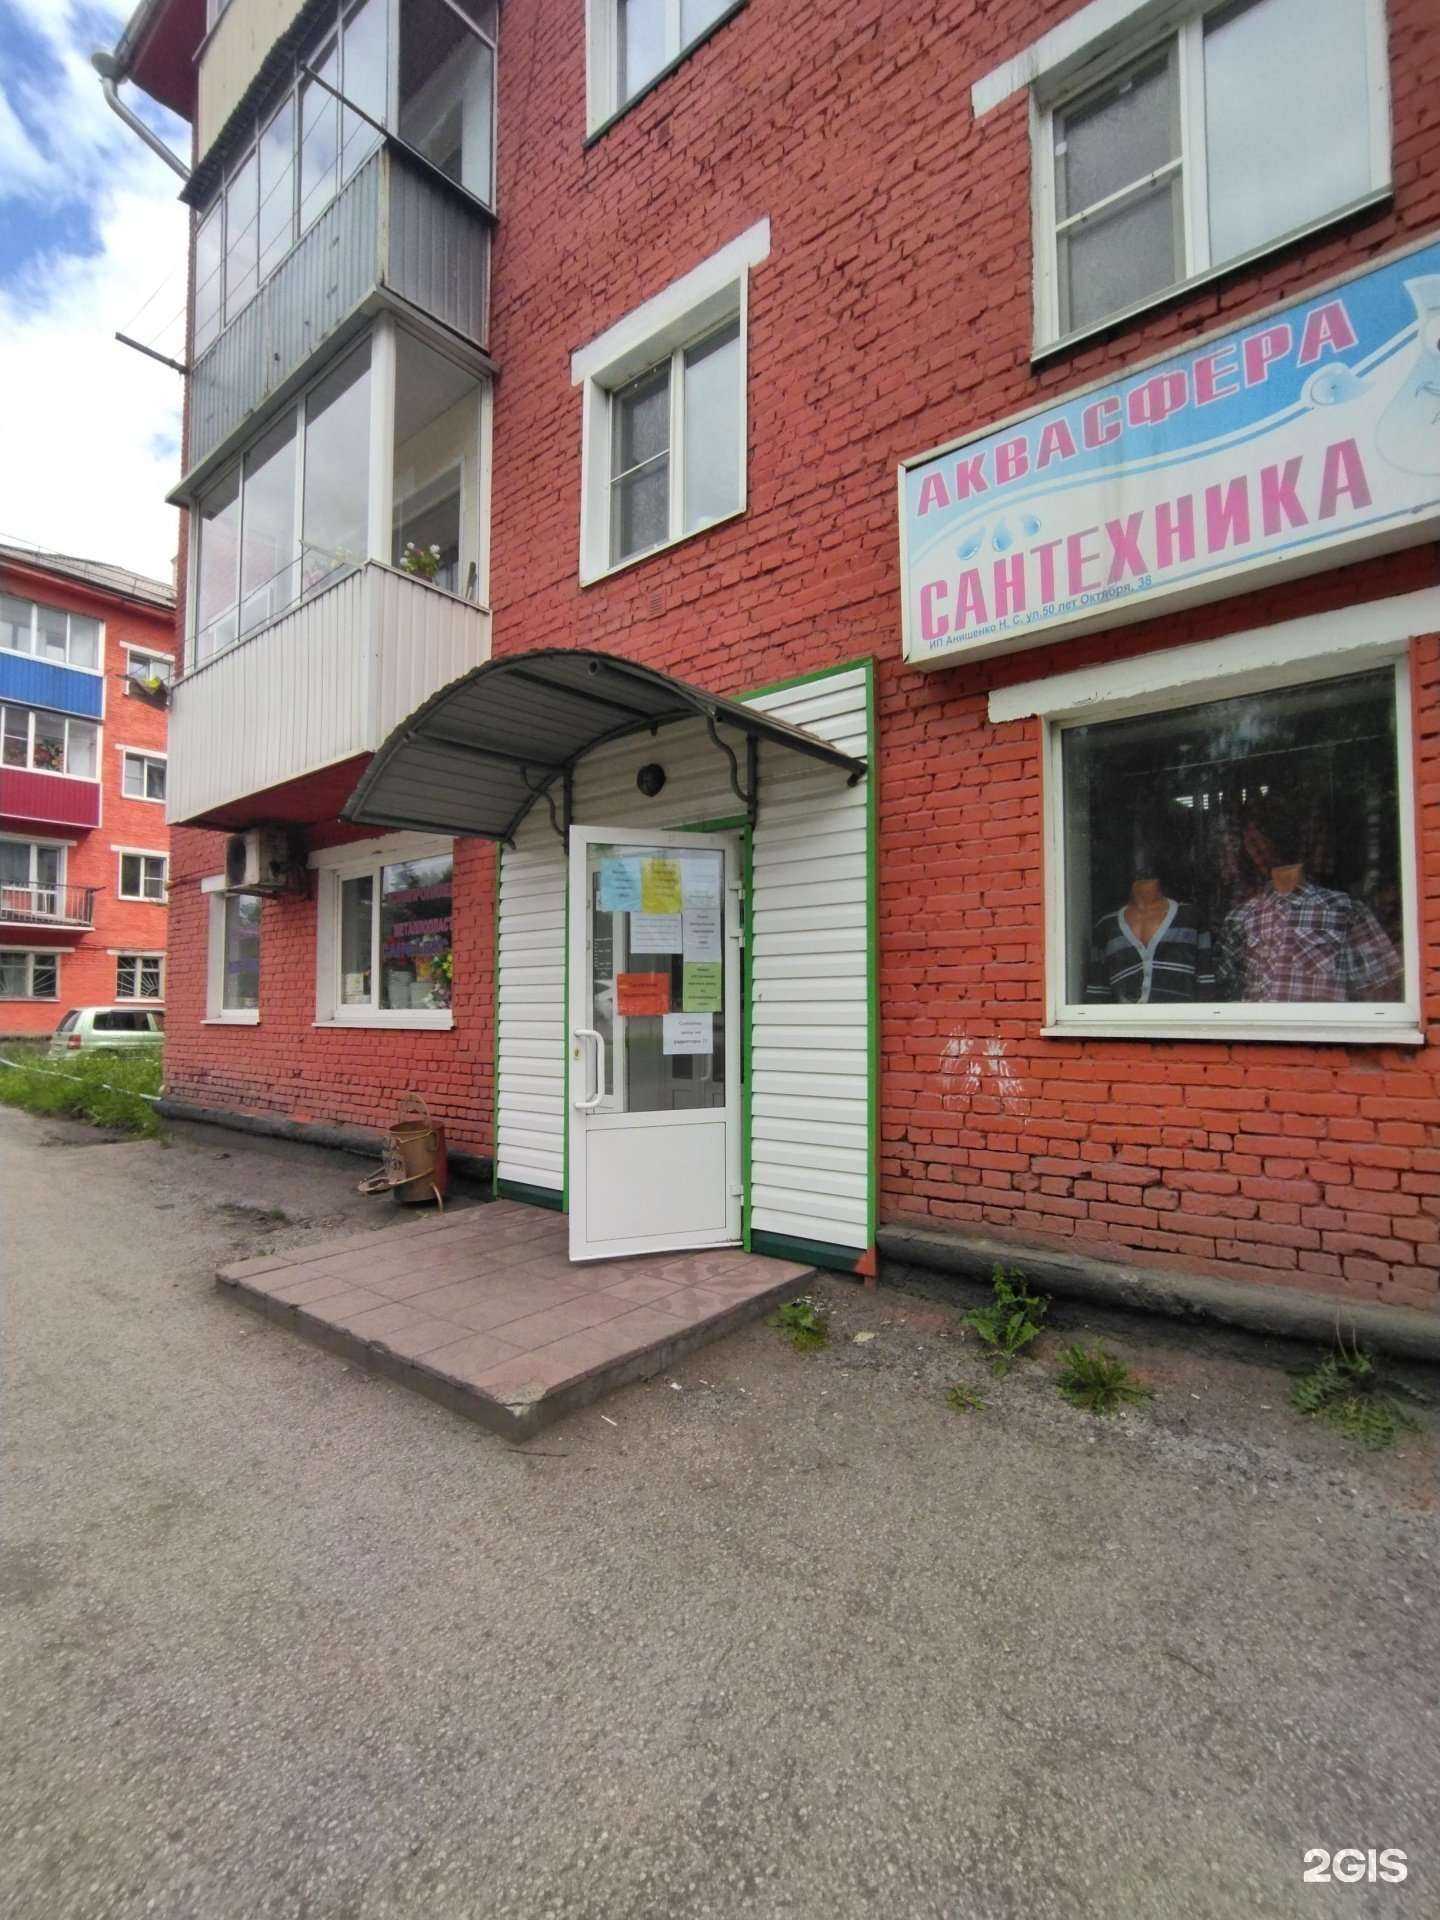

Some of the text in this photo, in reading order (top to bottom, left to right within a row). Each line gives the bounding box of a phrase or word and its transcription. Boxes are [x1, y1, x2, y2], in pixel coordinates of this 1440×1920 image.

[916, 299, 1358, 516] АКВАСФЕРА
[920, 438, 1373, 641] САНТЕХНИКА
[929, 638, 944, 650] ИП
[1057, 599, 1077, 614] лет
